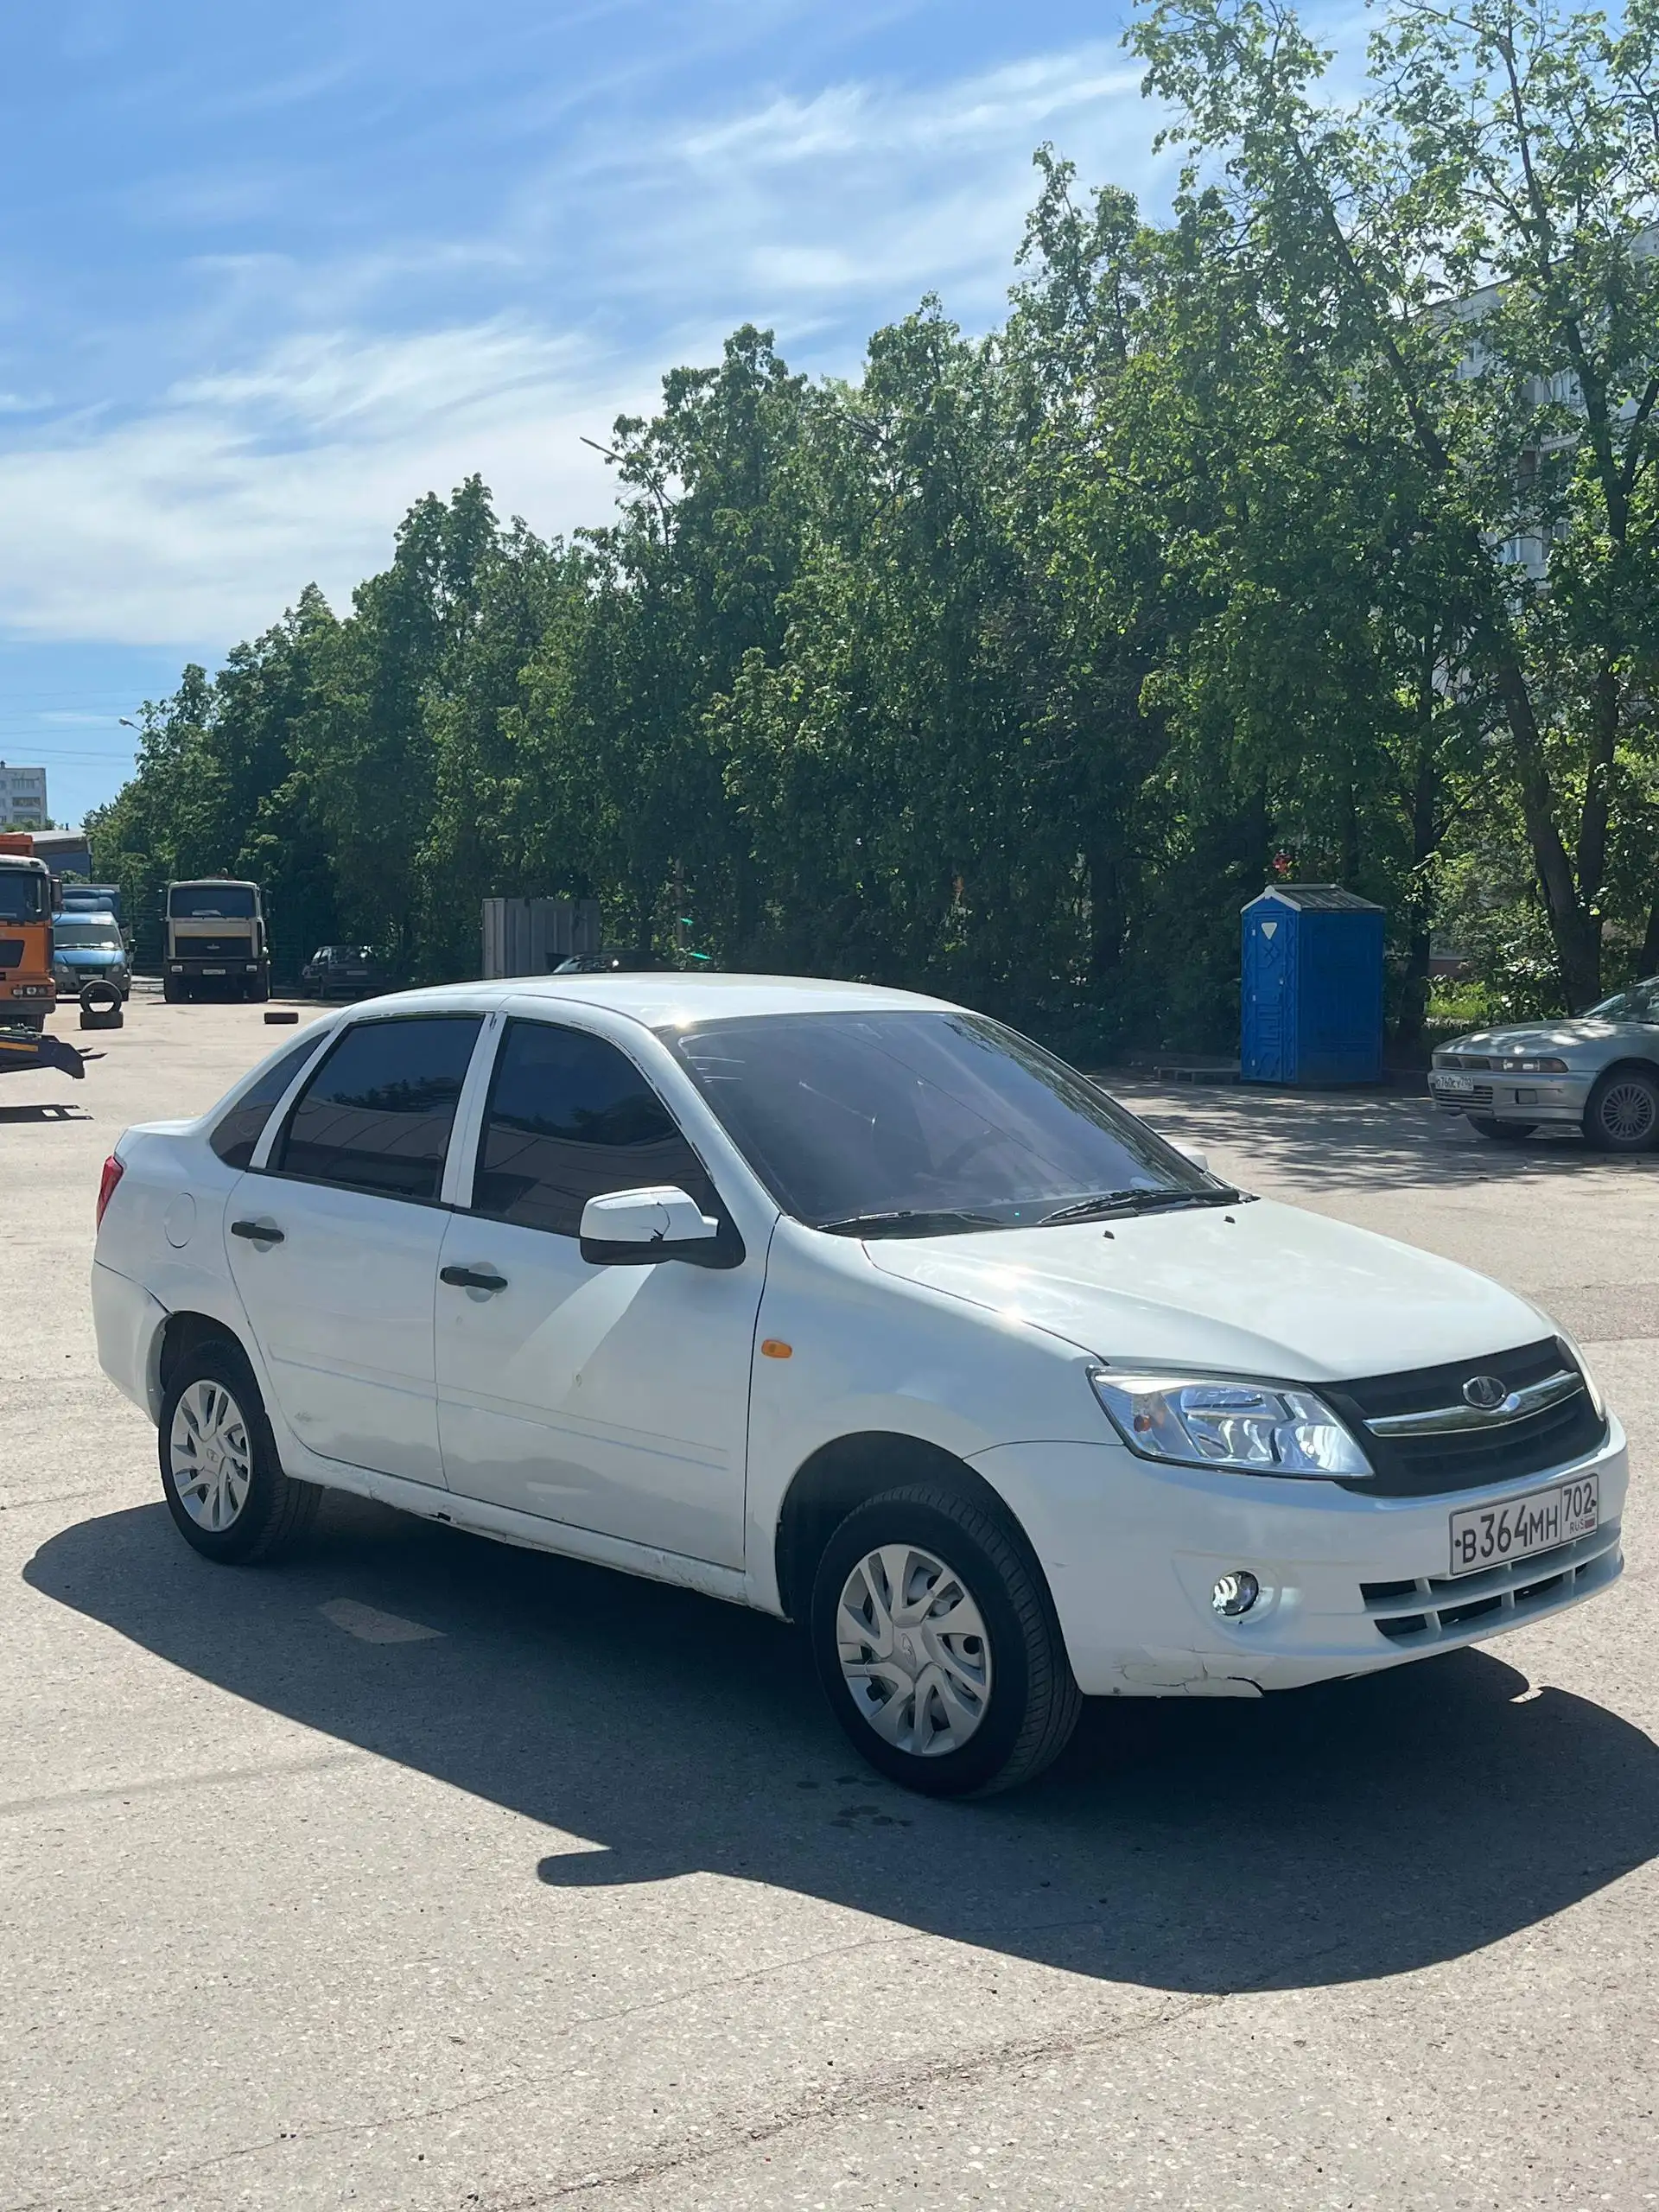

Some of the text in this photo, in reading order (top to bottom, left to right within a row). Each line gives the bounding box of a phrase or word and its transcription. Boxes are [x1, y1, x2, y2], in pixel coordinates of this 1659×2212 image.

[1462, 1482, 1593, 1564] В364МН 702
[1569, 1517, 1586, 1535] RUS
